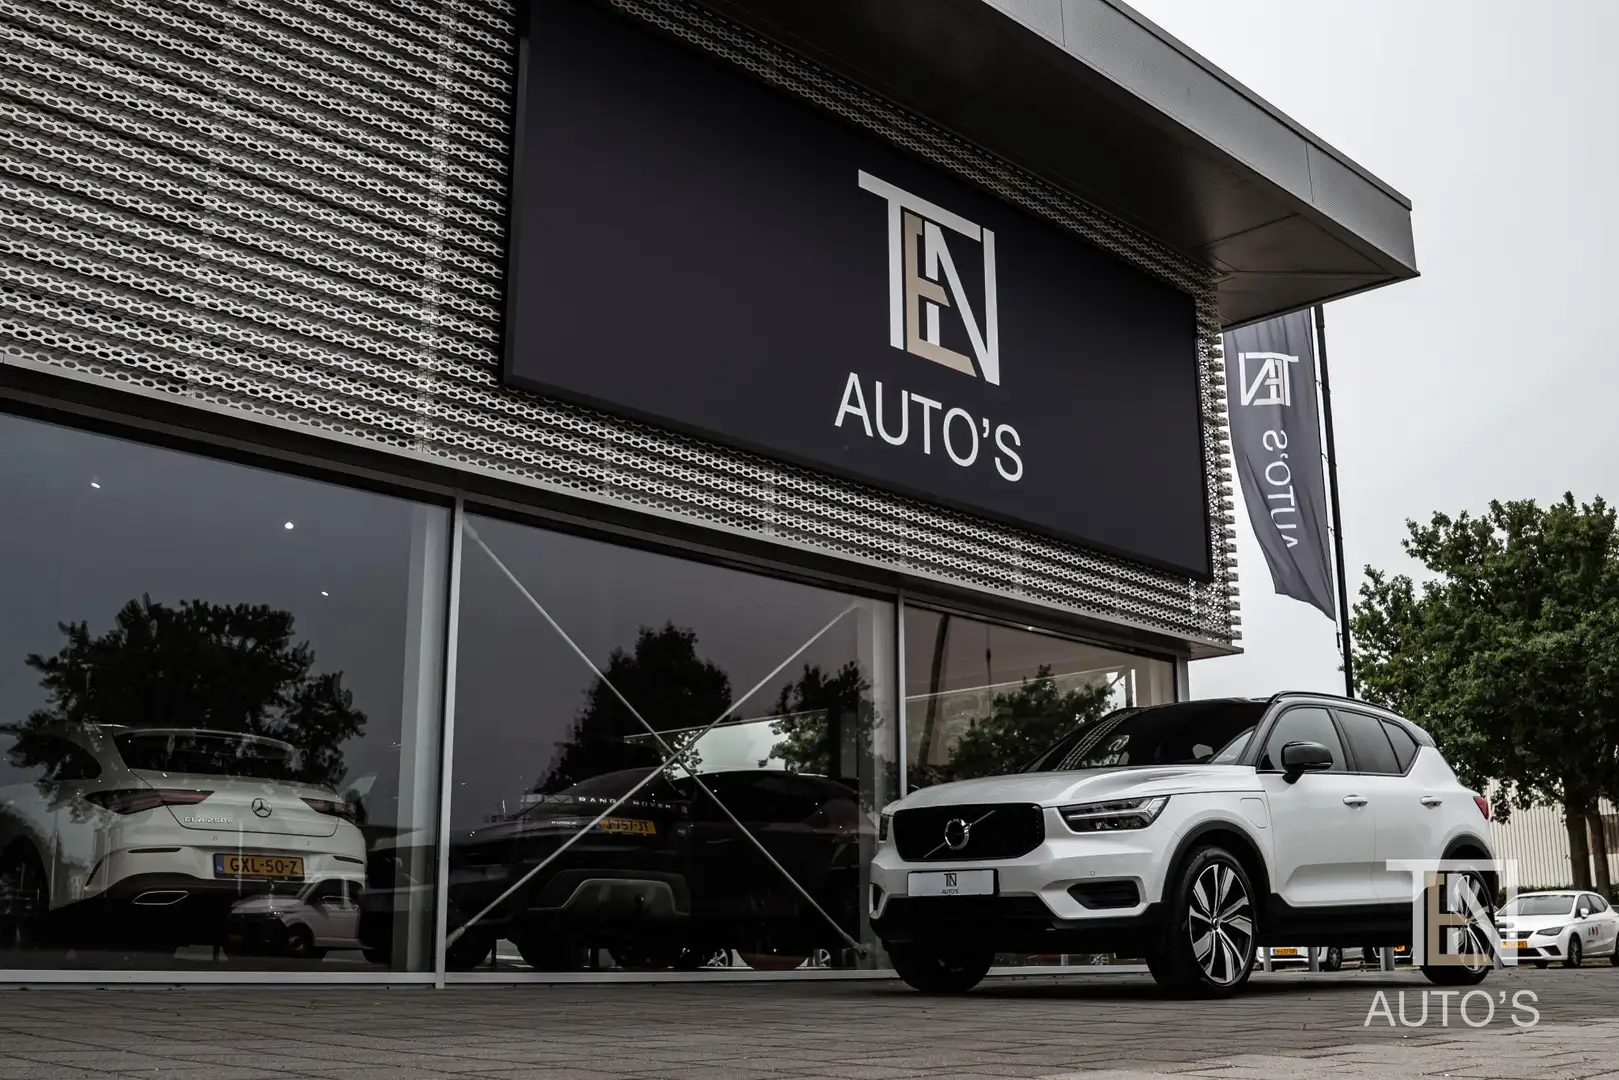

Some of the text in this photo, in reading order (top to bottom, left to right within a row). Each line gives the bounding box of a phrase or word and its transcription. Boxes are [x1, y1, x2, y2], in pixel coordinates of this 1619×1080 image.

[858, 168, 1000, 386] TEN
[834, 371, 1024, 482] AUTO'S
[230, 858, 298, 874] GXL-50-Z
